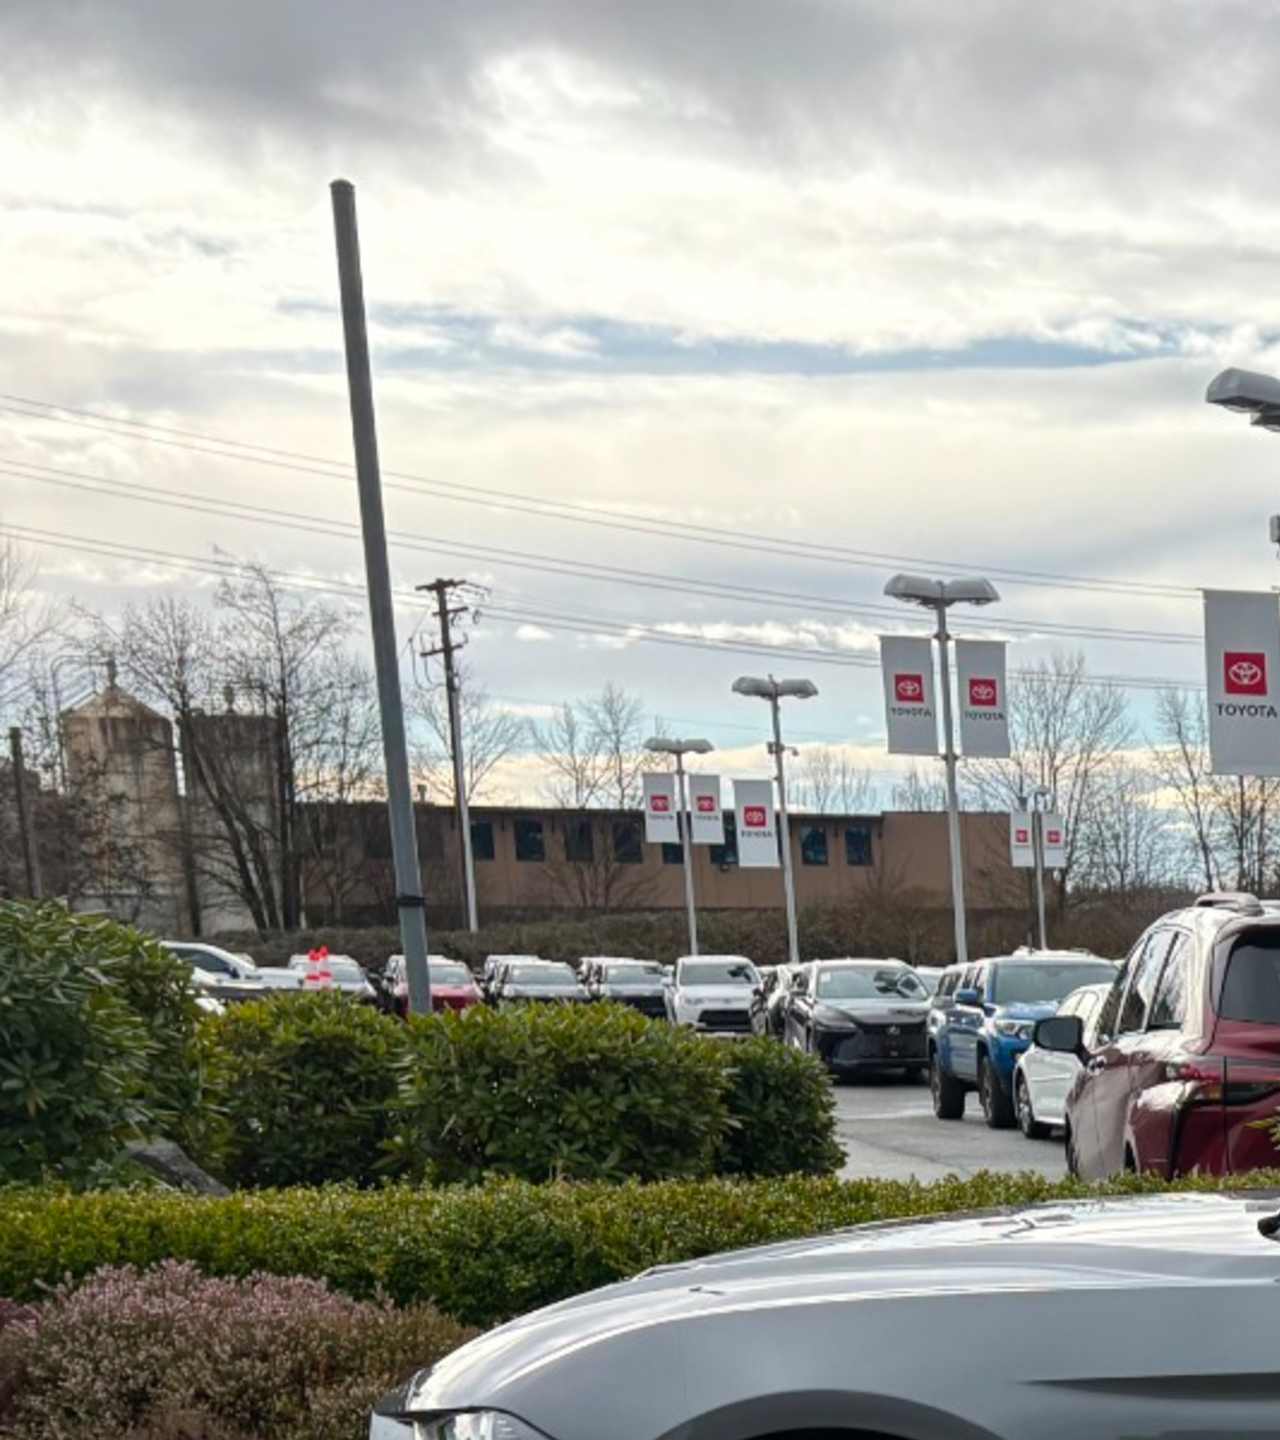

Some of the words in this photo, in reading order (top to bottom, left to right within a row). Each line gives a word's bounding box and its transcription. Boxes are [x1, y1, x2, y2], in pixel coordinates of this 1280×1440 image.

[891, 707, 932, 718] TOYOTA
[964, 710, 1005, 720] TOYOTA
[1216, 703, 1278, 718] TOYOTA
